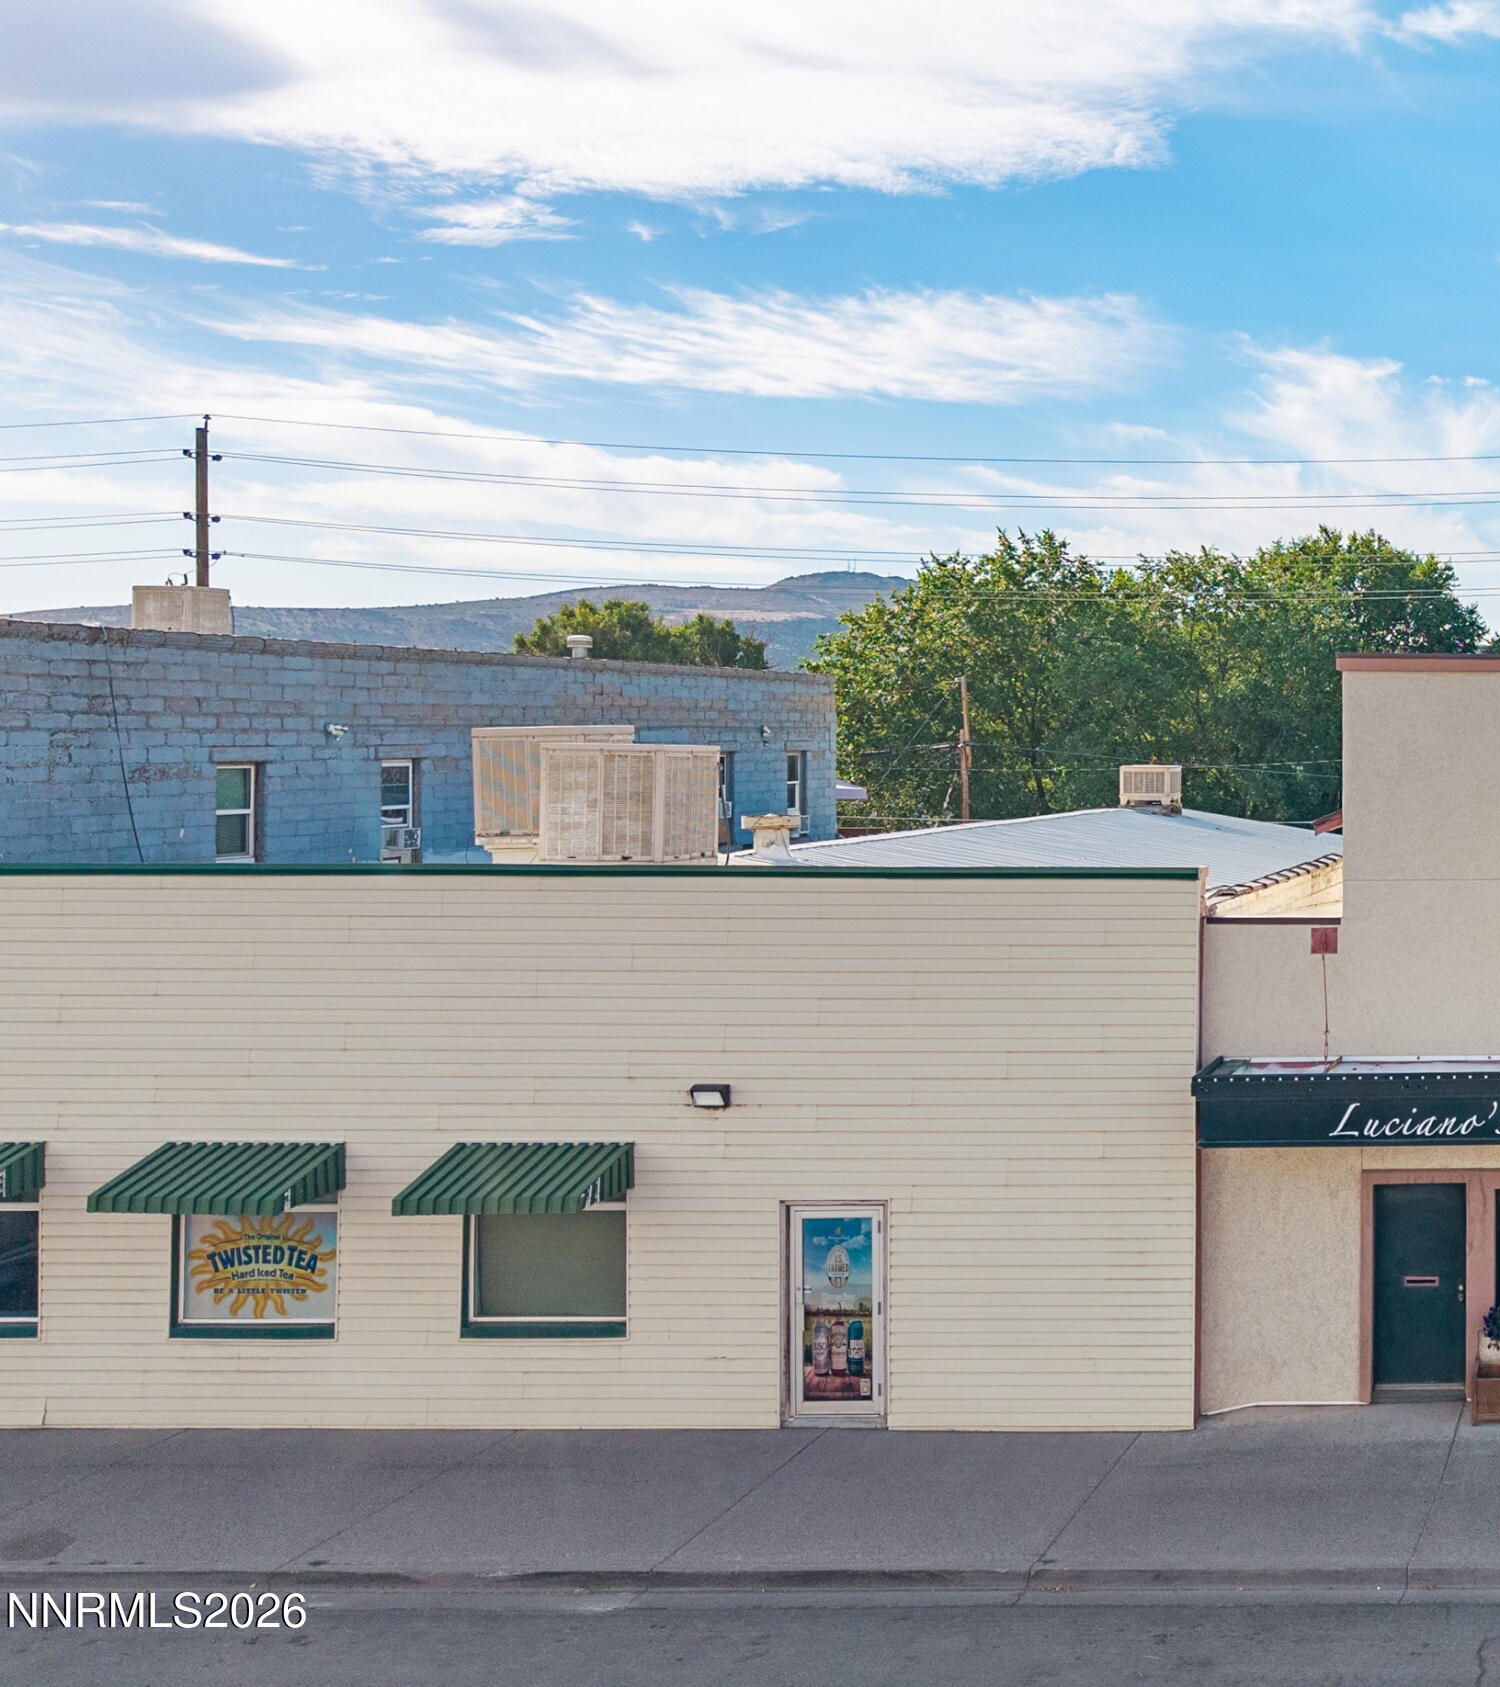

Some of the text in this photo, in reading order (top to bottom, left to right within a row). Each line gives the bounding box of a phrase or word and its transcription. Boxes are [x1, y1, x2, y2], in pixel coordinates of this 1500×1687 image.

[206, 1244, 319, 1275] TWISTED TEA
[231, 1268, 295, 1281] Hard Iced Tea
